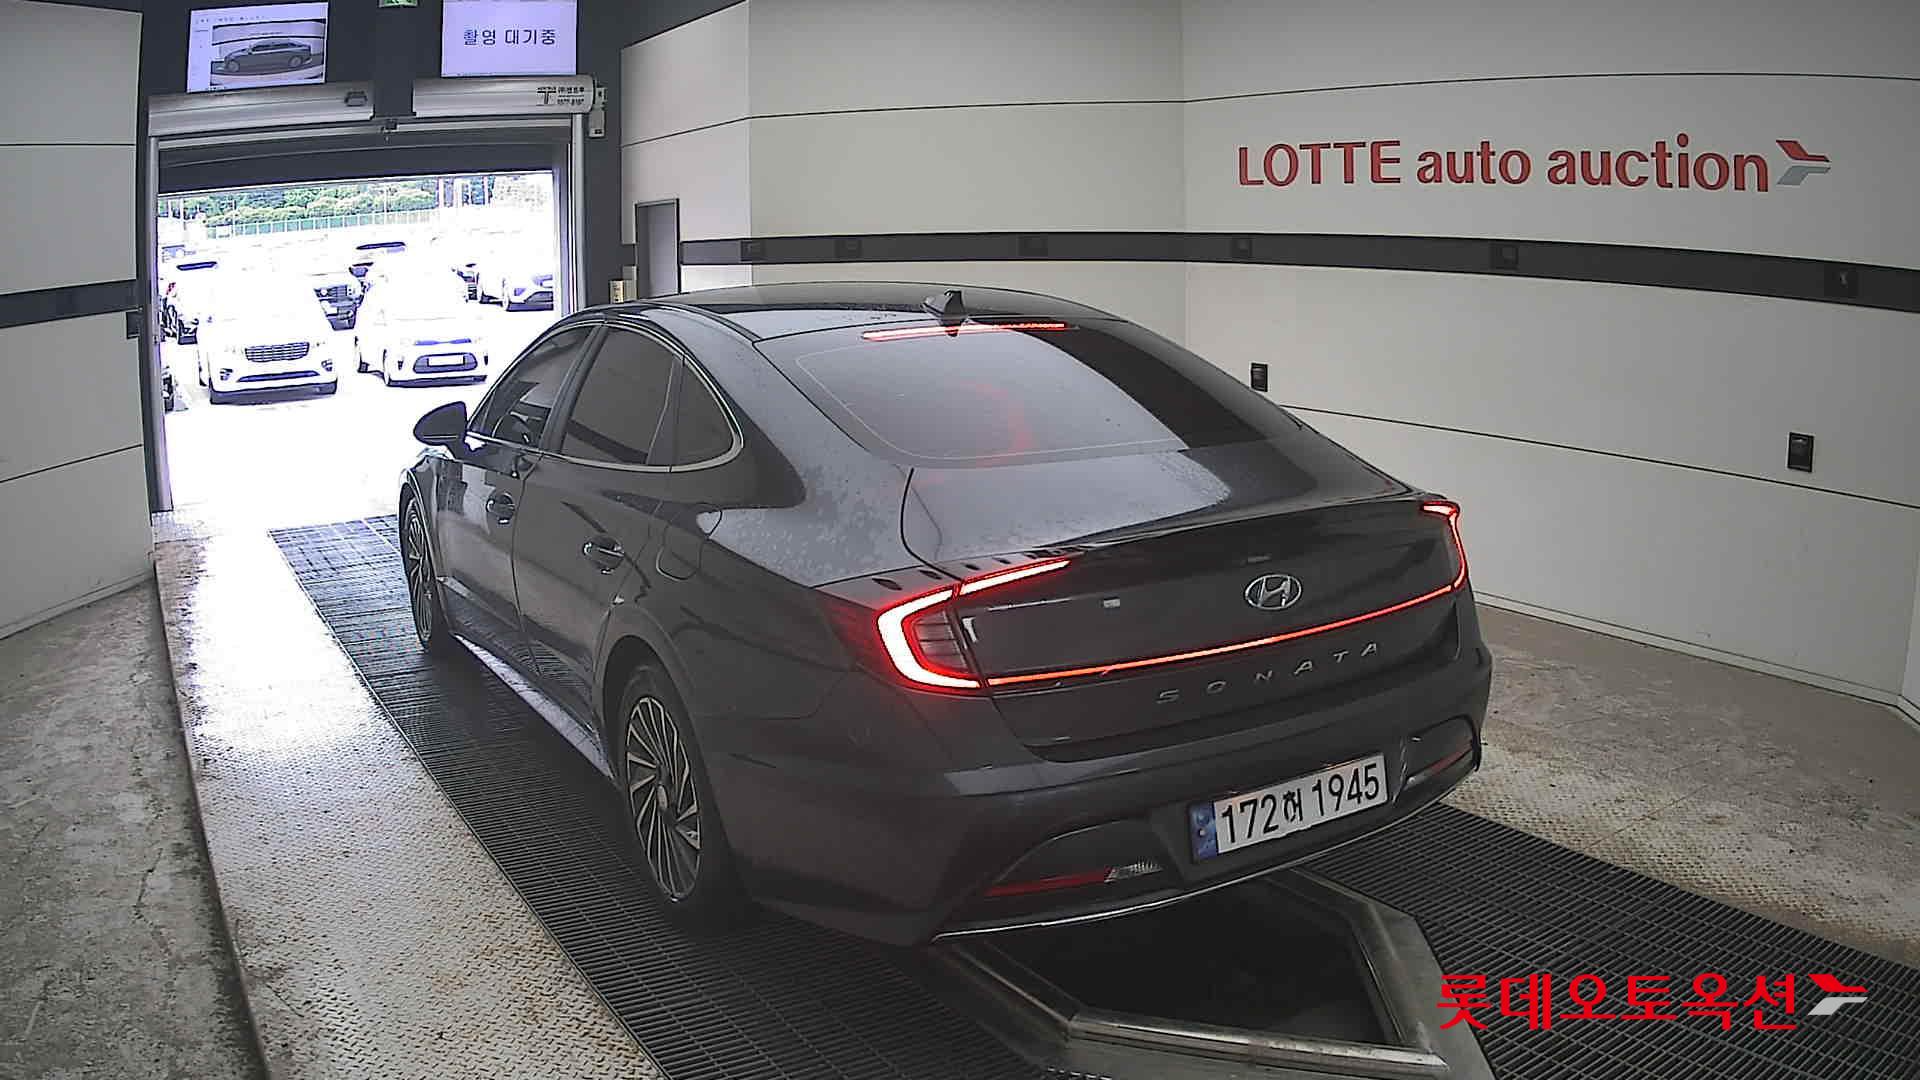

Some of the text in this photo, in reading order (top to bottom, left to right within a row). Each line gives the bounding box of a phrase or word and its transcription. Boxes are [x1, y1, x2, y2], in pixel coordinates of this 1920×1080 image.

[463, 29, 557, 46] 촬영 대기중
[1238, 133, 1770, 193] LOTTE auto auction
[1156, 642, 1378, 704] SONATA
[1221, 763, 1380, 844] 172허 1945
